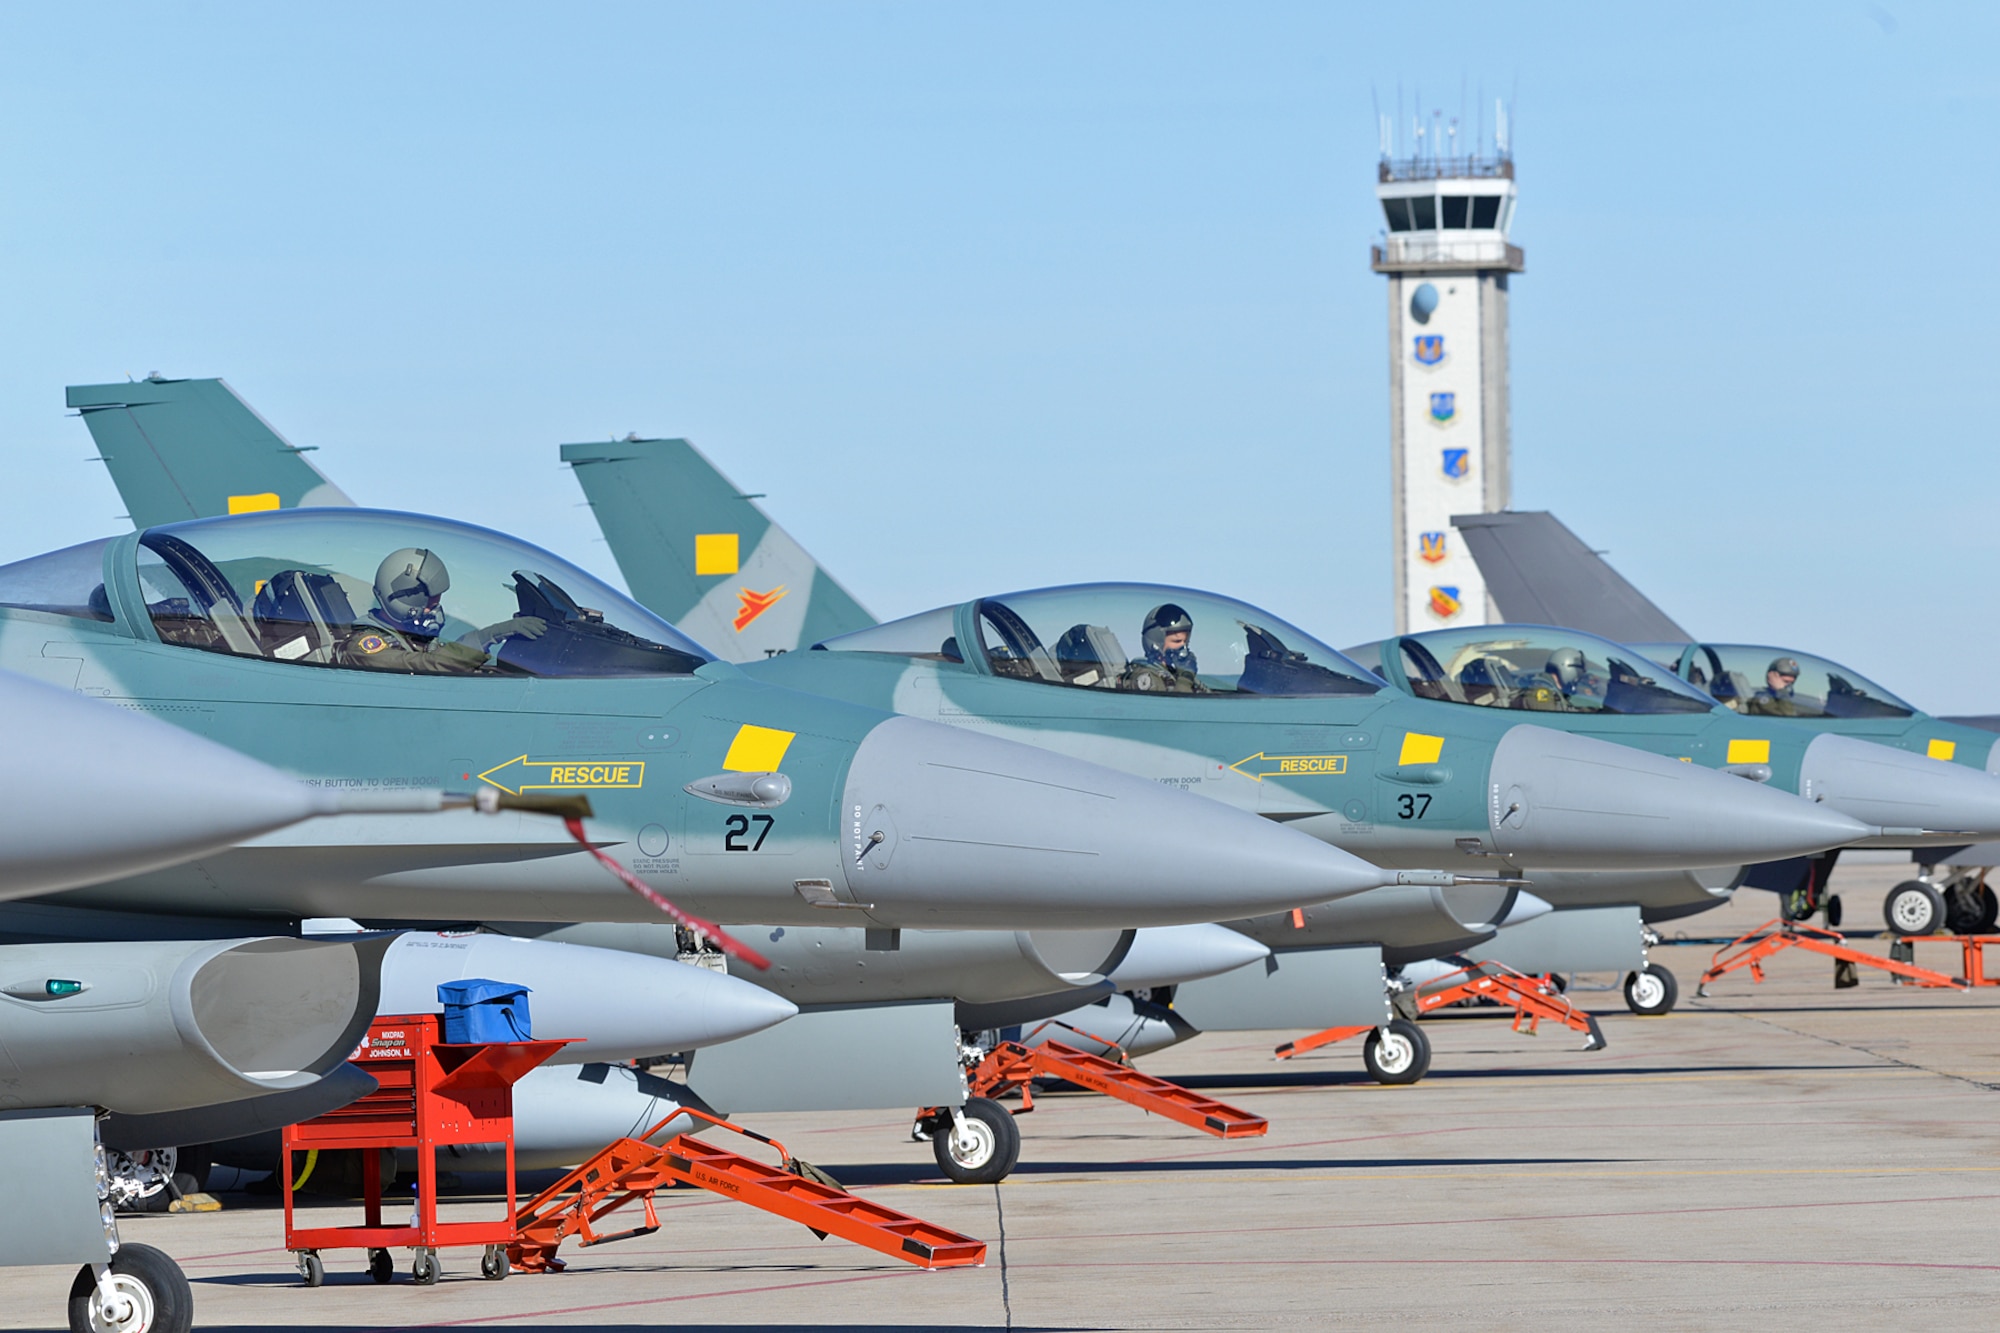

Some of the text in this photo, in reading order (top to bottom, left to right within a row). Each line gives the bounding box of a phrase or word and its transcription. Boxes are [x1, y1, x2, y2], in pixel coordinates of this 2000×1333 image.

[1280, 759, 1337, 772] RESCUE
[325, 778, 363, 788] BUTTON
[367, 778, 378, 787] TO
[382, 777, 409, 787] OPEN
[412, 776, 440, 786] DOOR
[550, 766, 631, 784] RESCUE
[854, 804, 862, 818] DO
[1397, 793, 1433, 820] 37
[725, 814, 775, 851] 27
[853, 821, 861, 840] NOT
[369, 1048, 412, 1058] JOHNSON, M.
[695, 1171, 740, 1194] U.S. AIR FORCE
